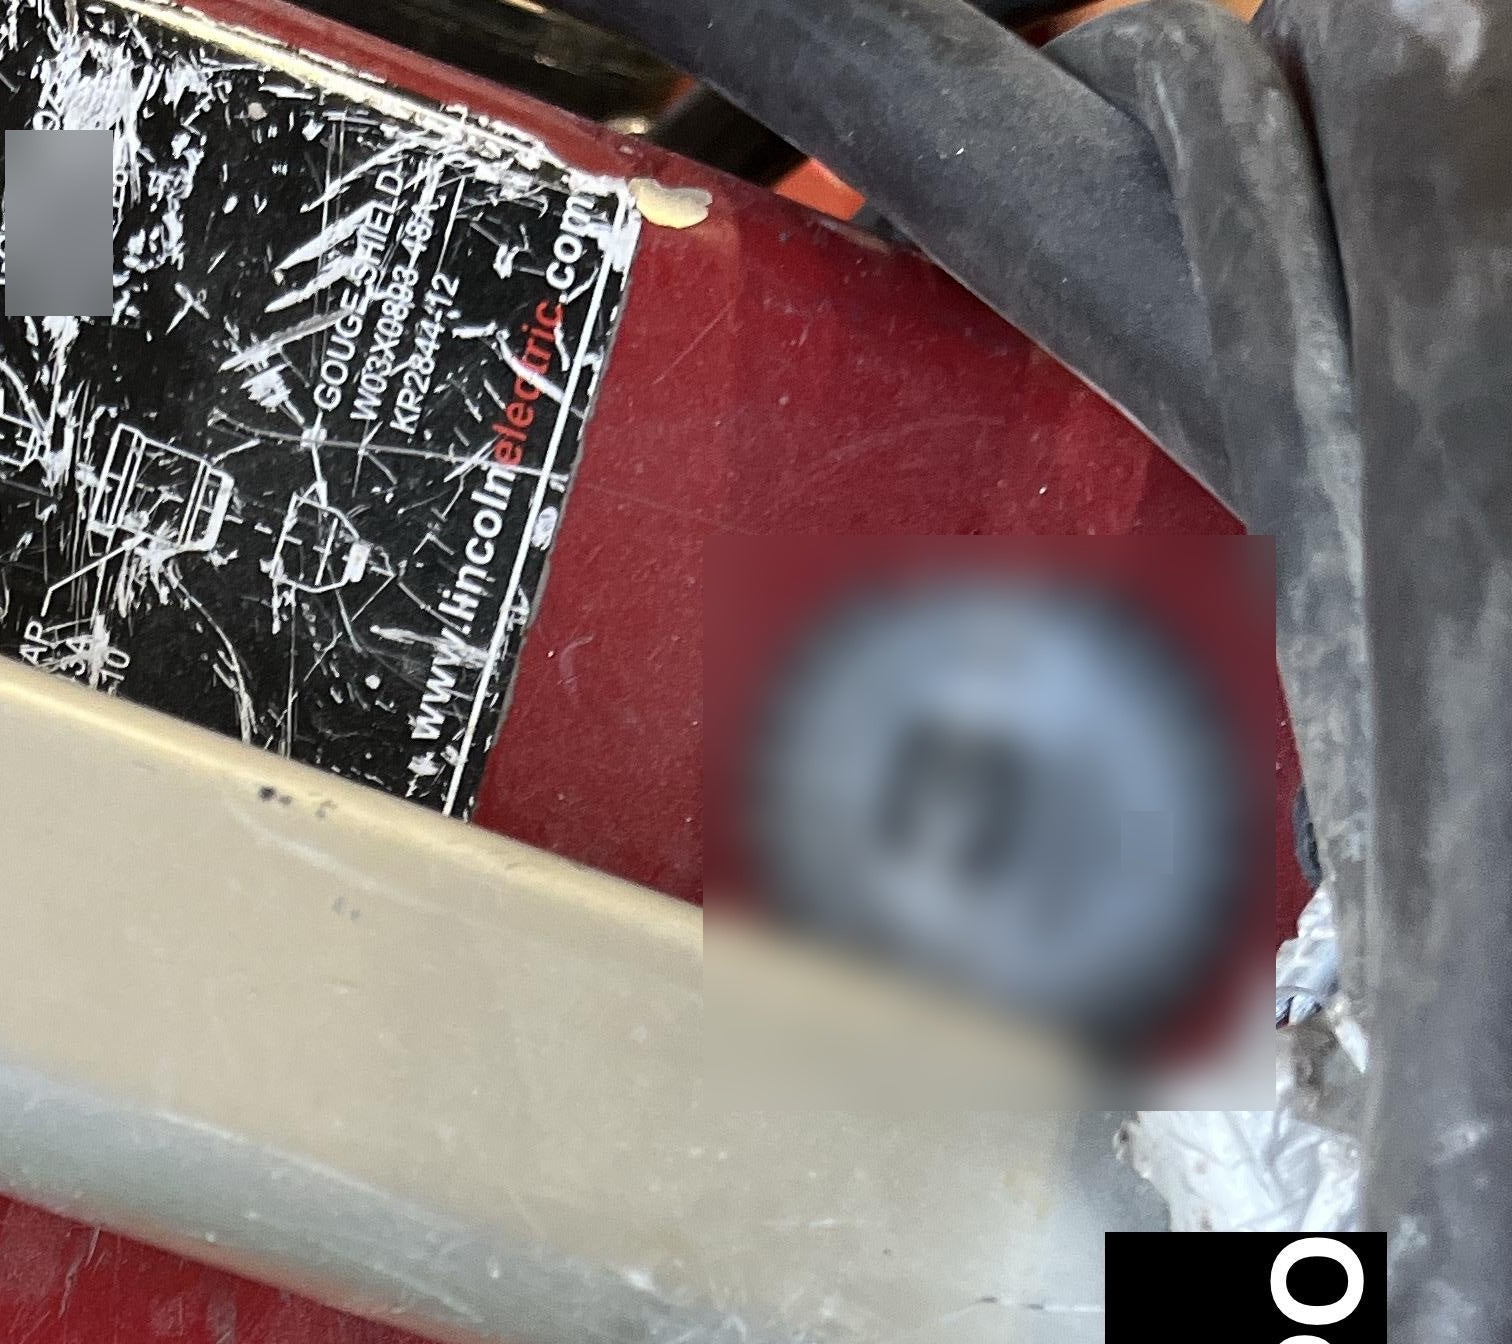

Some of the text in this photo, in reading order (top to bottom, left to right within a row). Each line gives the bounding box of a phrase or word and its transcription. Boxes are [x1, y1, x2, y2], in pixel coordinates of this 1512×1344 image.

[313, 169, 411, 412] GOUGE SHIELD
[410, 192, 598, 741] www.lincolnelectric.com
